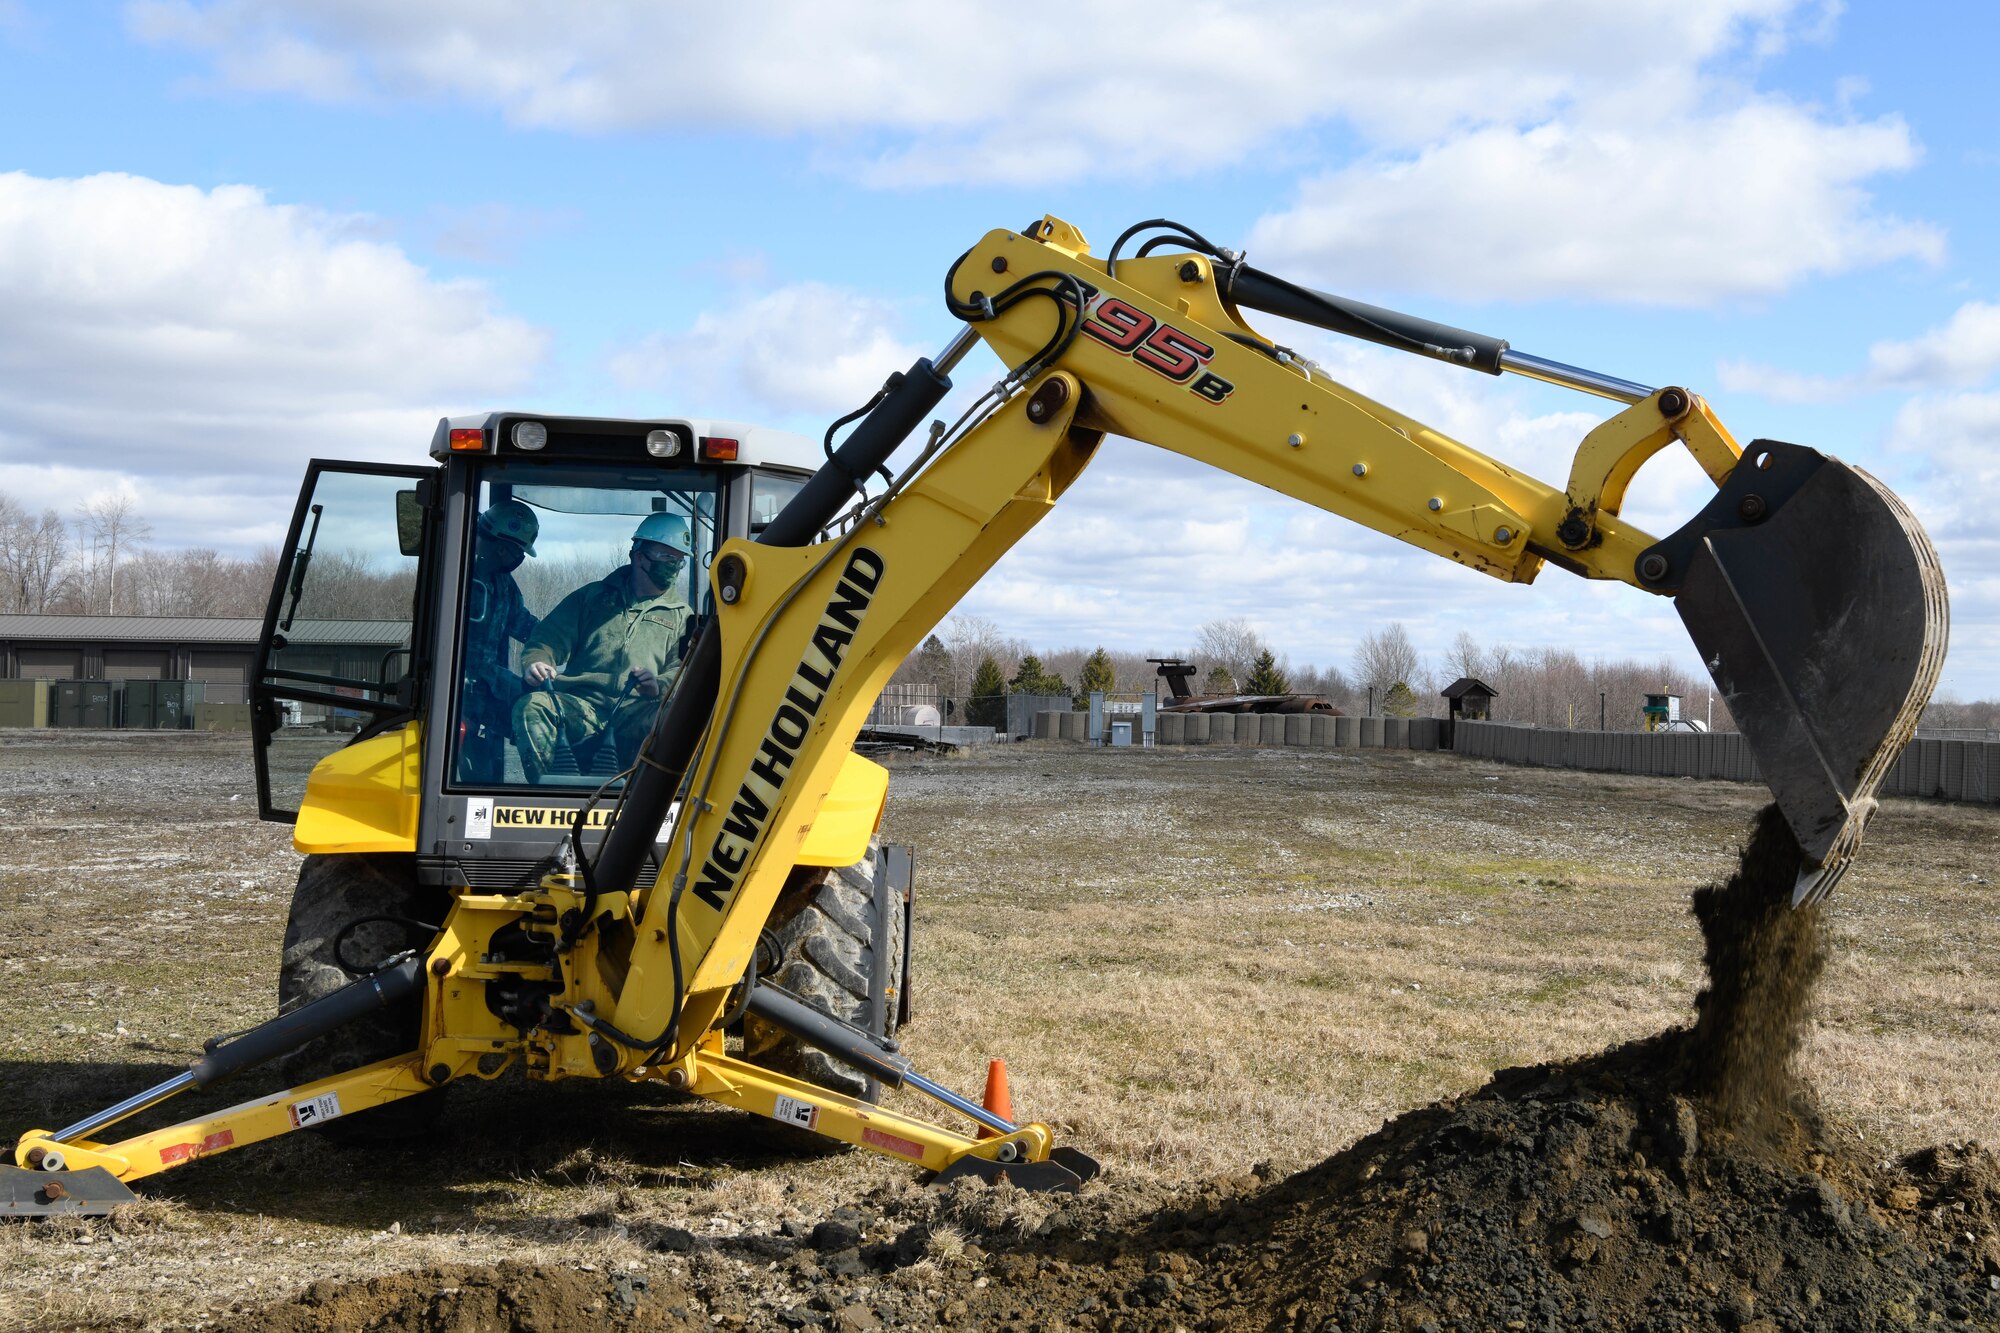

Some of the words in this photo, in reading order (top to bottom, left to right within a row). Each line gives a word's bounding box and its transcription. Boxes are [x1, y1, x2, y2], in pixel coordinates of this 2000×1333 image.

[496, 808, 545, 824] NEW
[692, 782, 770, 912] NEW
[750, 547, 886, 790] HOLLAND
